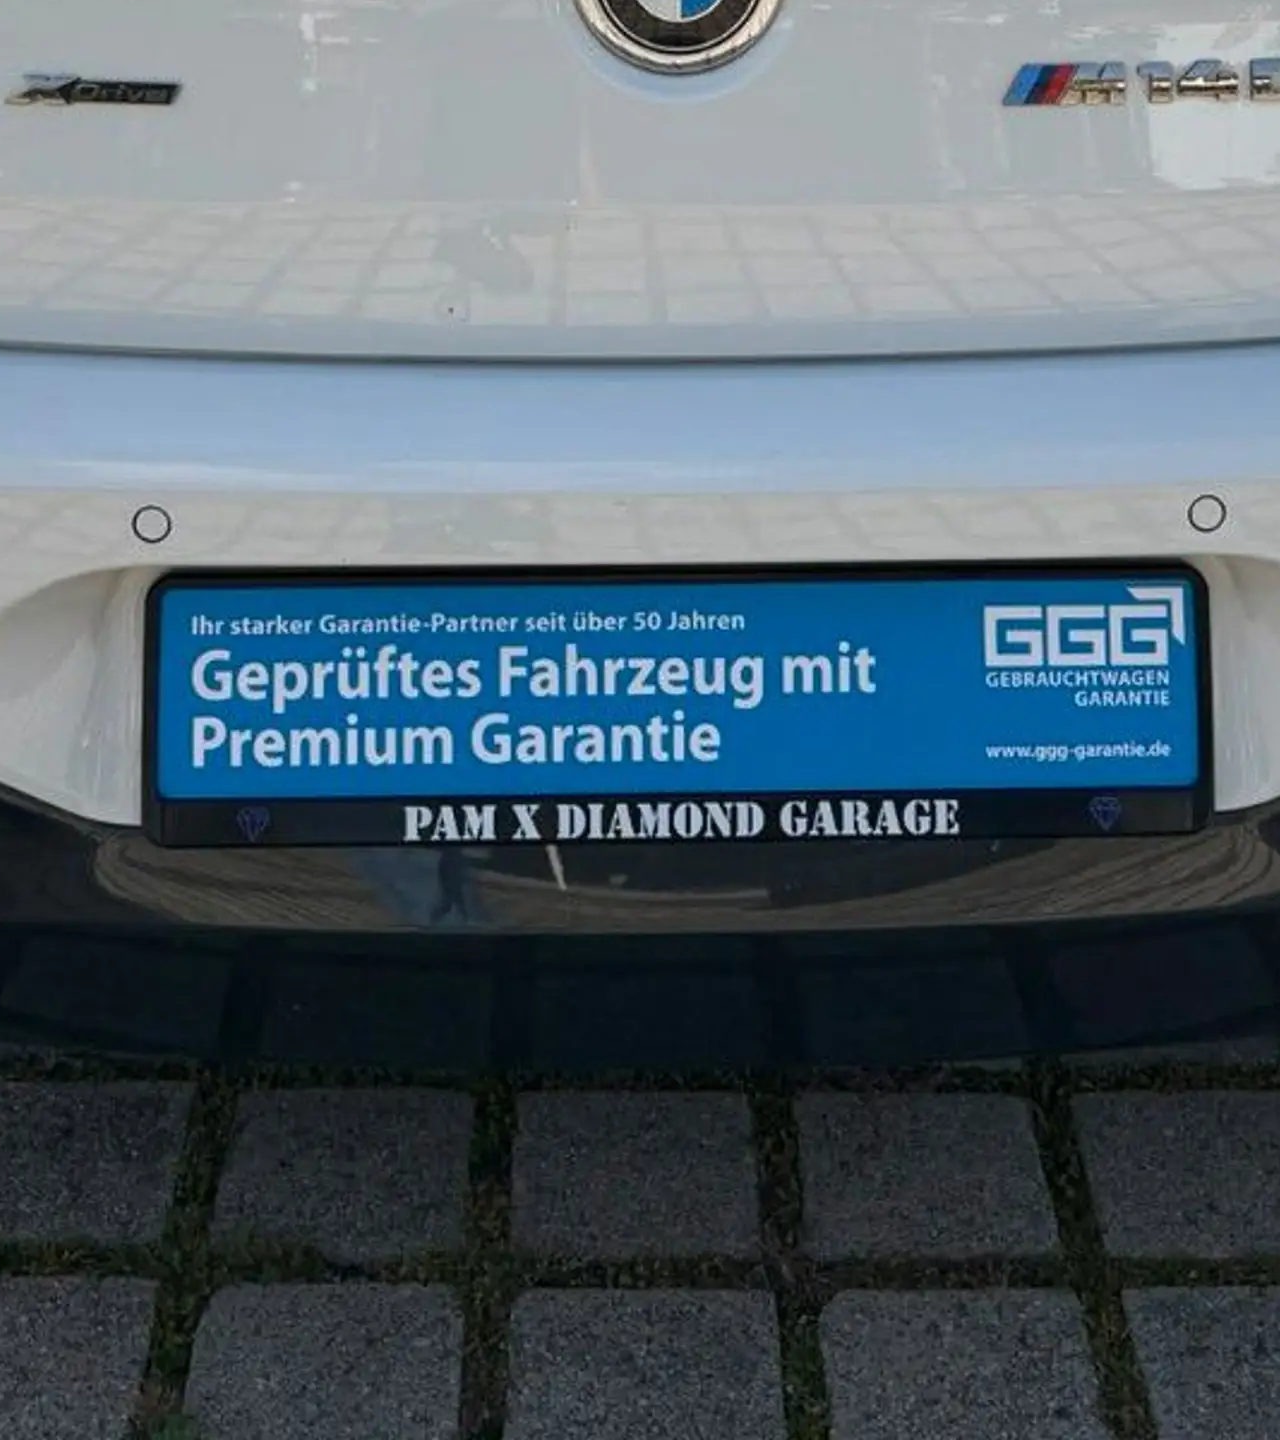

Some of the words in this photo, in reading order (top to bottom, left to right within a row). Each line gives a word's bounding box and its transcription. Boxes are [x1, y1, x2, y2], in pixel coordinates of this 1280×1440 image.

[191, 615, 224, 636] Ihr
[230, 615, 312, 636] starker
[319, 613, 519, 635] Garantie-Partner
[525, 612, 566, 632] seit
[572, 611, 626, 631] über
[634, 611, 662, 631] 50
[667, 610, 745, 631] Jahren
[983, 605, 1169, 667] GGG
[191, 645, 482, 714] Geprüftes
[498, 644, 764, 709] Fahrzeug
[782, 641, 876, 694] mit
[985, 669, 1170, 688] GEBRAUCHTWAGEN
[1074, 690, 1170, 707] GARANTIE
[192, 713, 454, 767] Premium
[471, 710, 721, 764] Garantie
[985, 740, 1171, 762] www.ggg-garantie.de
[402, 804, 497, 842] PAM
[511, 803, 541, 841] X
[555, 801, 765, 840] DIAMOND
[778, 798, 961, 838] GARAGE
